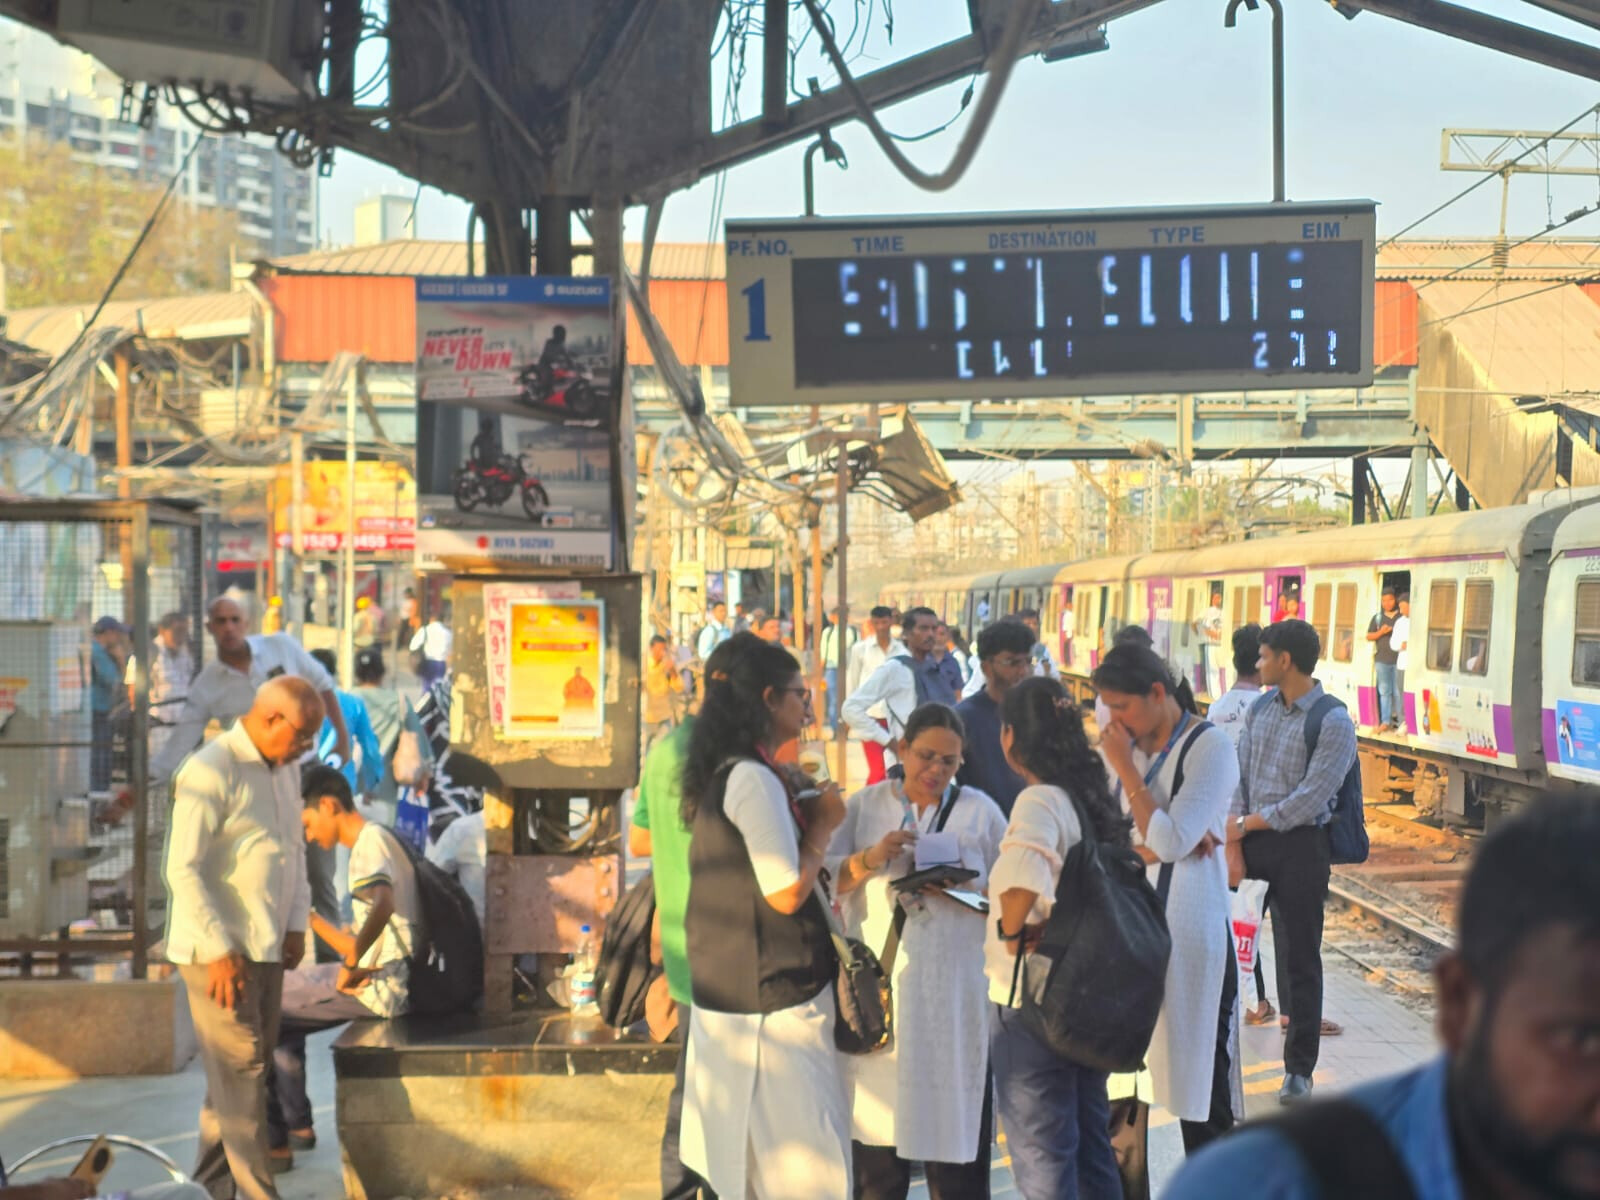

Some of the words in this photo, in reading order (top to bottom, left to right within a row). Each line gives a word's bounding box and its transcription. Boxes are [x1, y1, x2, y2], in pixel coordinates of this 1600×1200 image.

[727, 239, 794, 257] PF.NO.
[852, 235, 905, 253] TIME
[988, 230, 1097, 249] DESTINATION
[1150, 226, 1205, 243] TYPE
[1302, 222, 1341, 239] EIM
[556, 285, 604, 296] SUZUKI
[741, 277, 772, 342] 1
[422, 336, 484, 357] NEVER
[455, 349, 513, 372] DOWN
